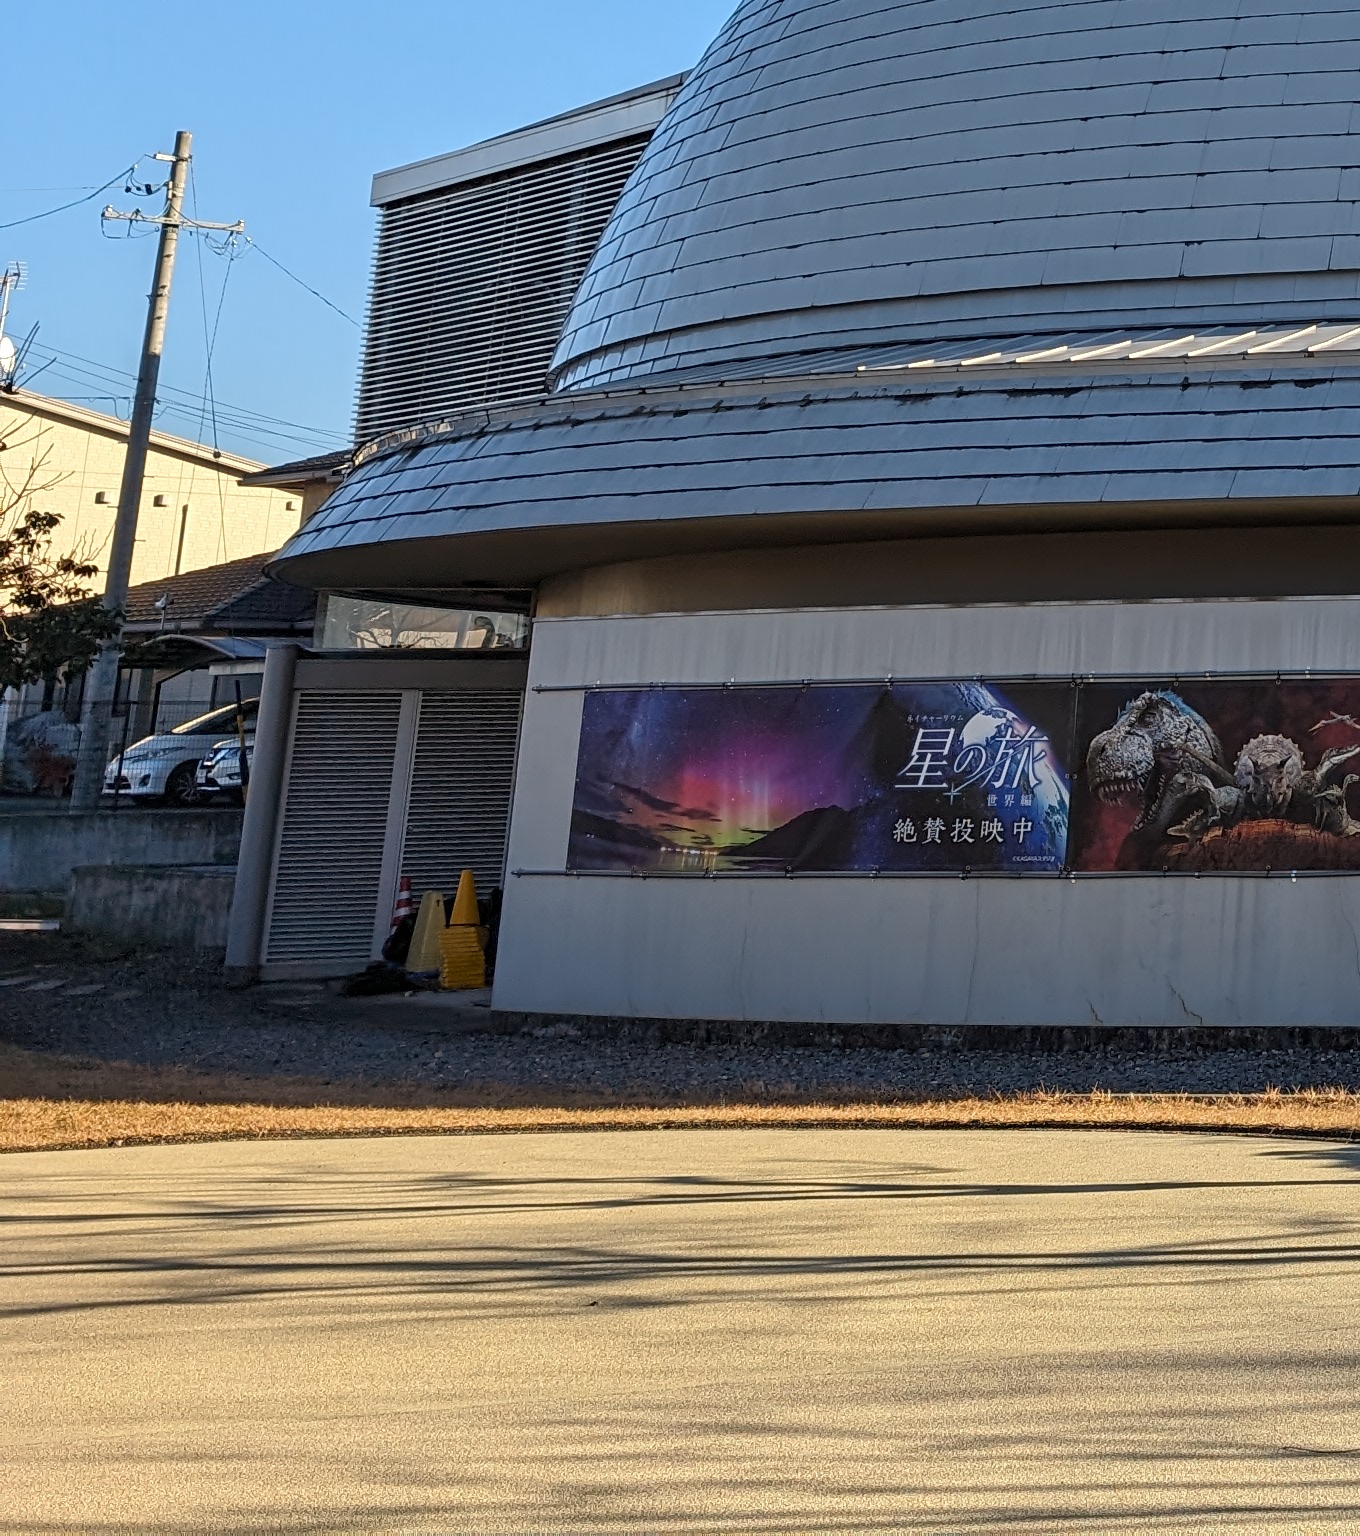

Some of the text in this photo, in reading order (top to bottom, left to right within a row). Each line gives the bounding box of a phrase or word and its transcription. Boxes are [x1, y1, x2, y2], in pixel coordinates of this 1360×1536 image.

[894, 725, 1049, 789] 星の旅
[986, 793, 1033, 807] 世界編
[892, 816, 1033, 845] 絶賛投映中
